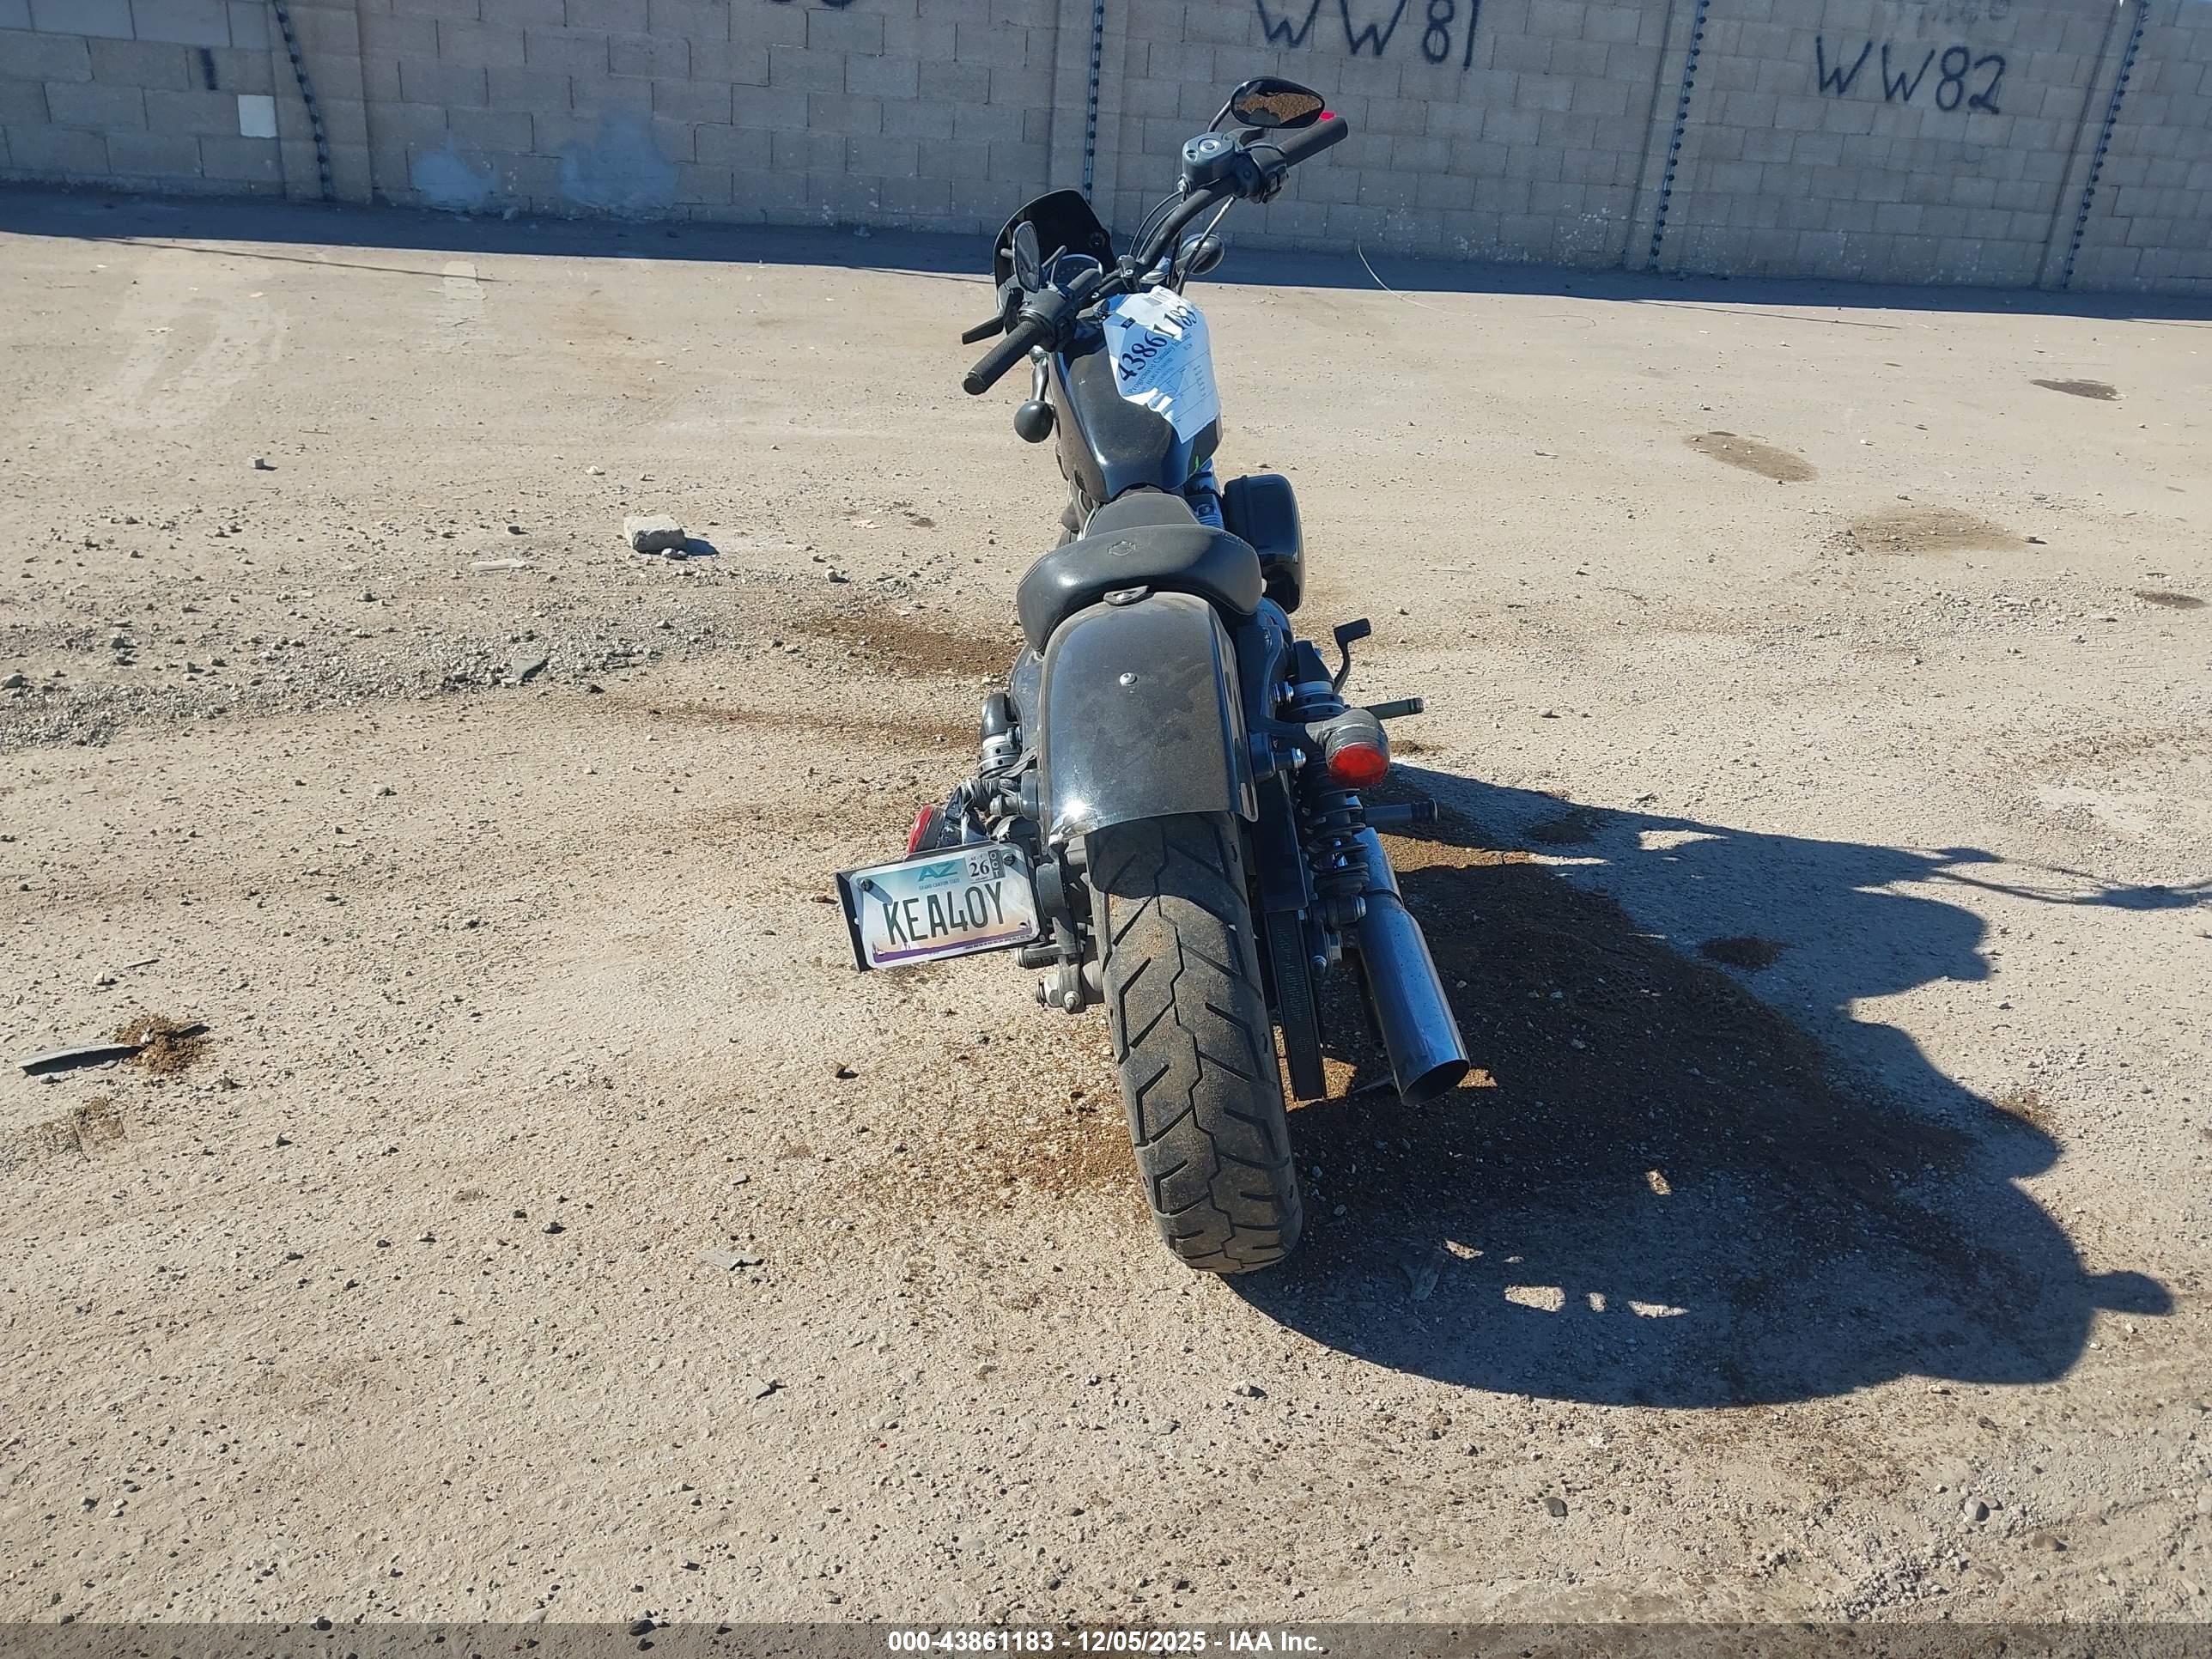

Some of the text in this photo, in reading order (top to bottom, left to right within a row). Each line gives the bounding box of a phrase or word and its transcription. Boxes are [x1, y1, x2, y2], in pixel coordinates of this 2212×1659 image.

[1816, 35, 2006, 114] WW82
[1118, 305, 1197, 381] 43861183
[918, 860, 958, 882] AZ
[969, 859, 990, 878] 26
